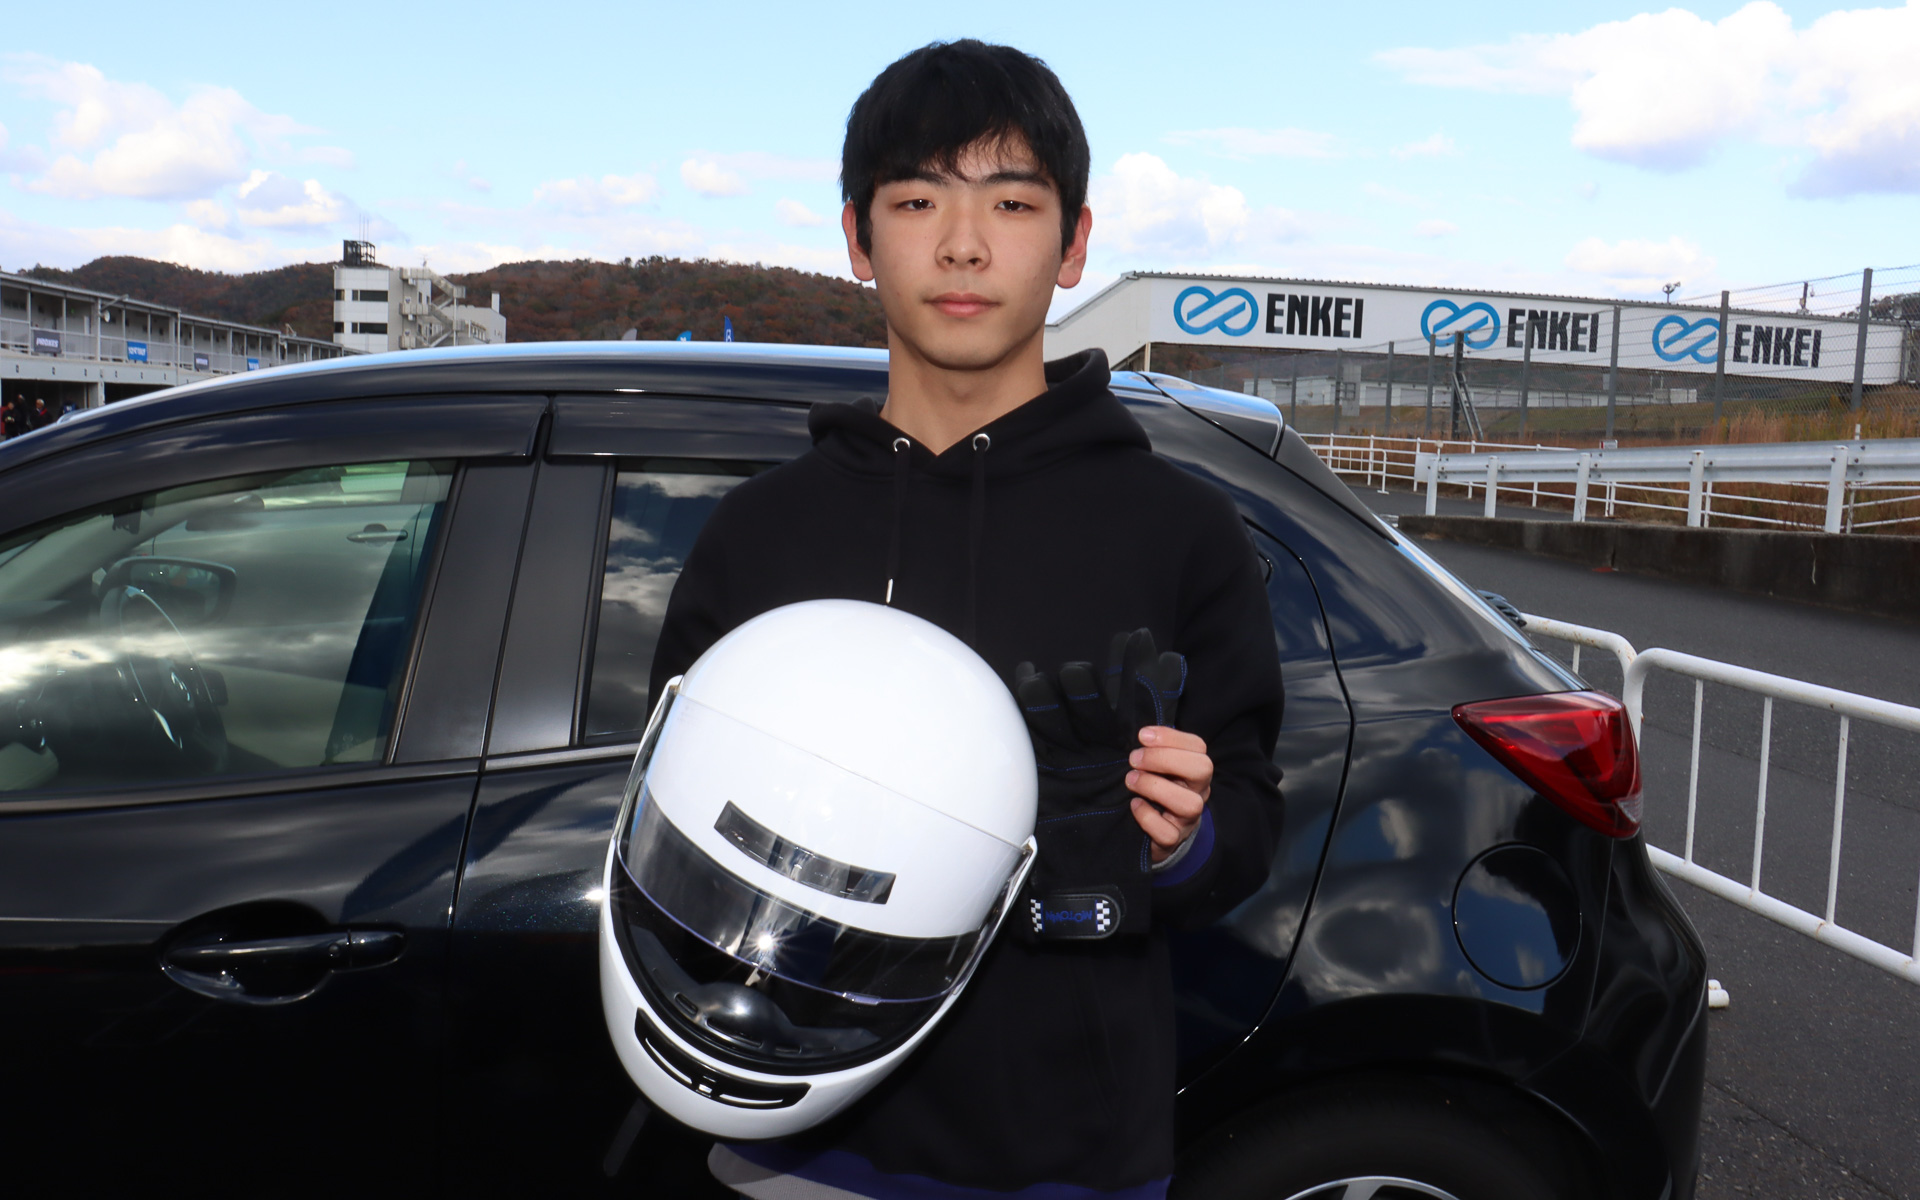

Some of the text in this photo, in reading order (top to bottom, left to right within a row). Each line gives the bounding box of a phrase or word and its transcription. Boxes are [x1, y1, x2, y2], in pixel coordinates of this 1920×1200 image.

[1265, 293, 1364, 339] ENKEI
[1506, 308, 1599, 353] ENKEI
[1732, 324, 1822, 368] ENKEI
